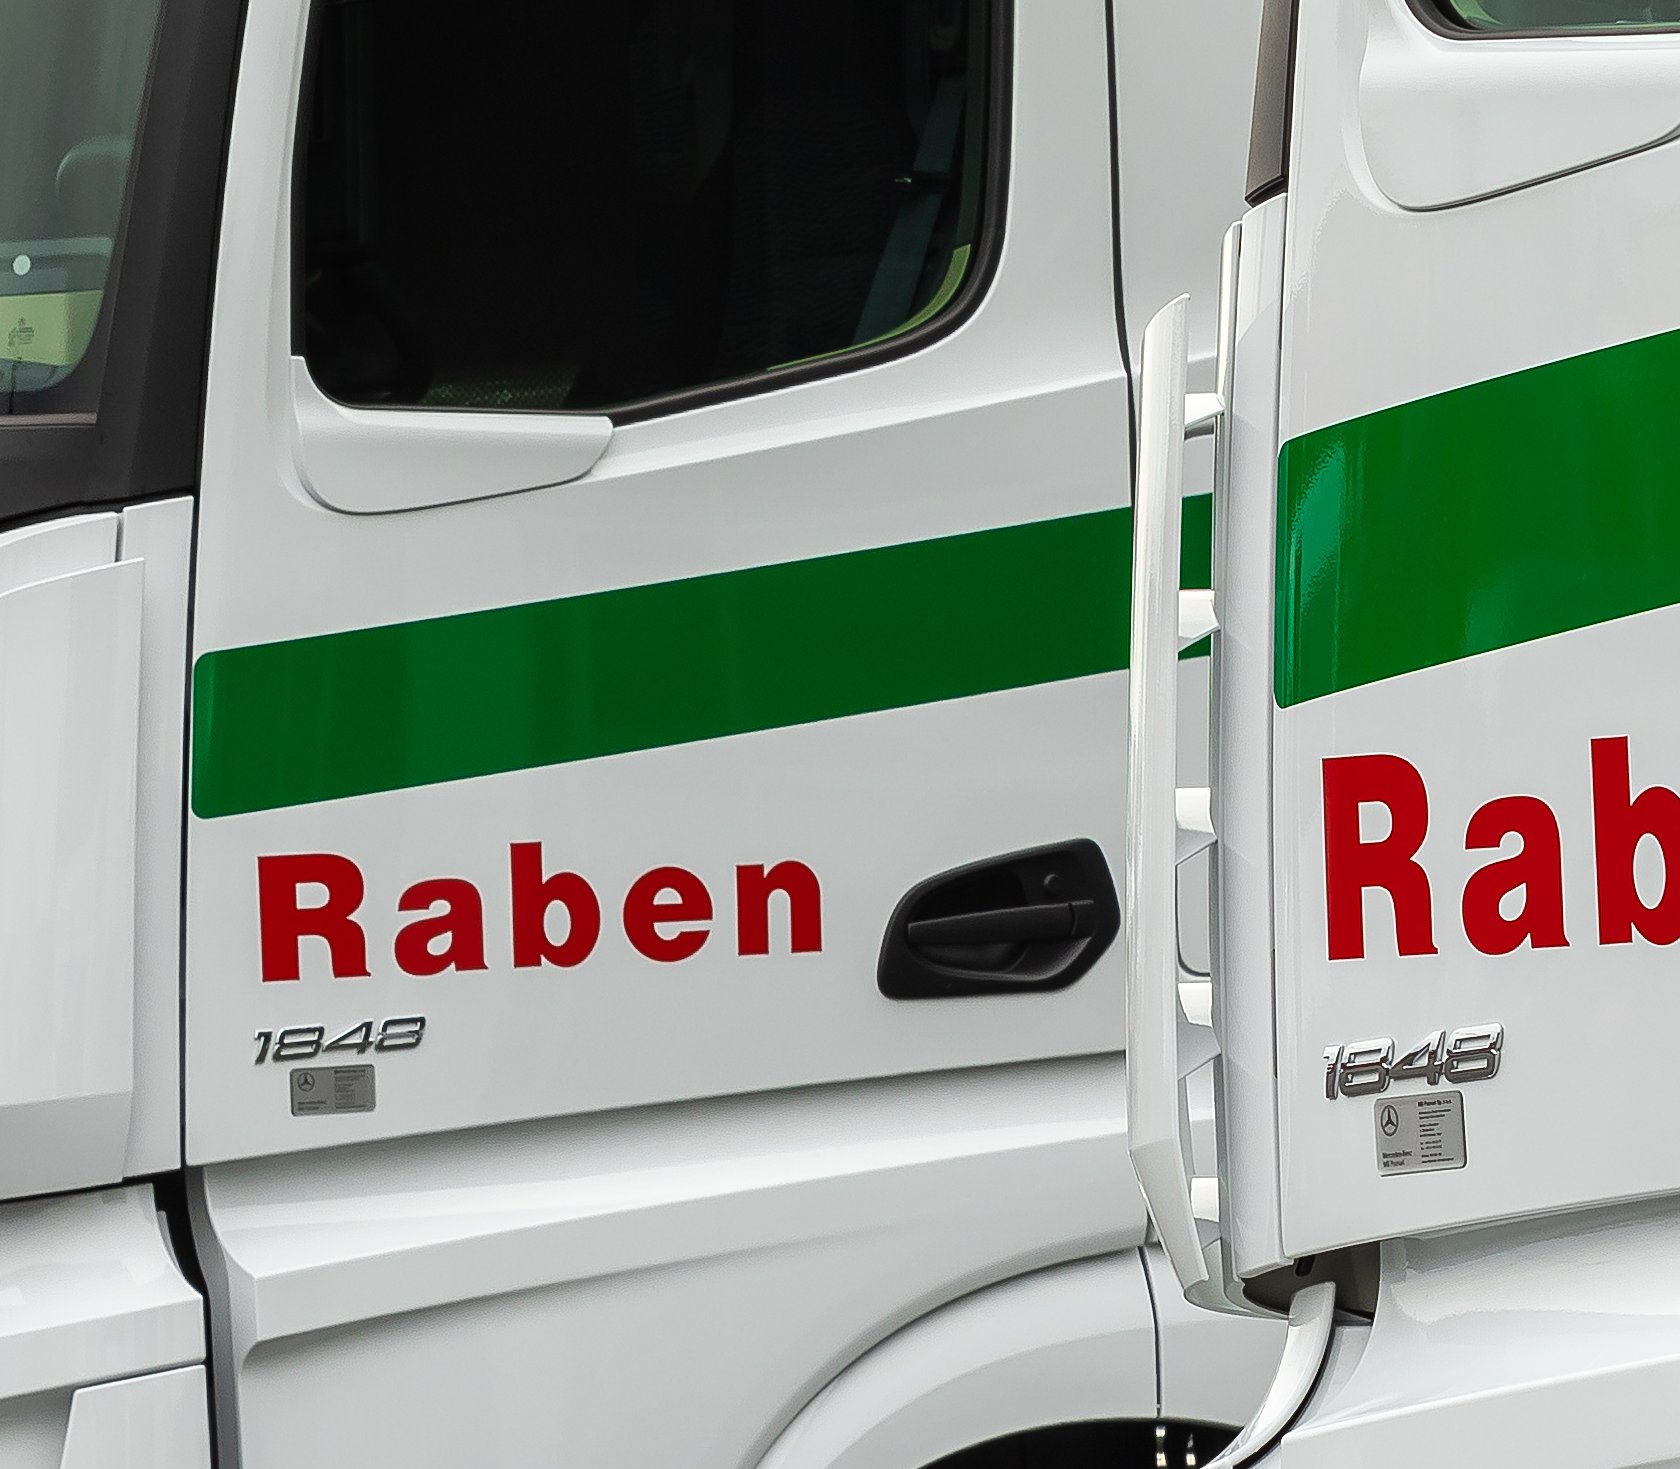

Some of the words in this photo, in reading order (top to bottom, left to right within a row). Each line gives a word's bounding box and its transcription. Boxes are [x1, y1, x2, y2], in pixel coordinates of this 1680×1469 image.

[256, 841, 823, 983] Raben
[254, 1014, 427, 1066] 1848
[1323, 1022, 1505, 1101] 1848
